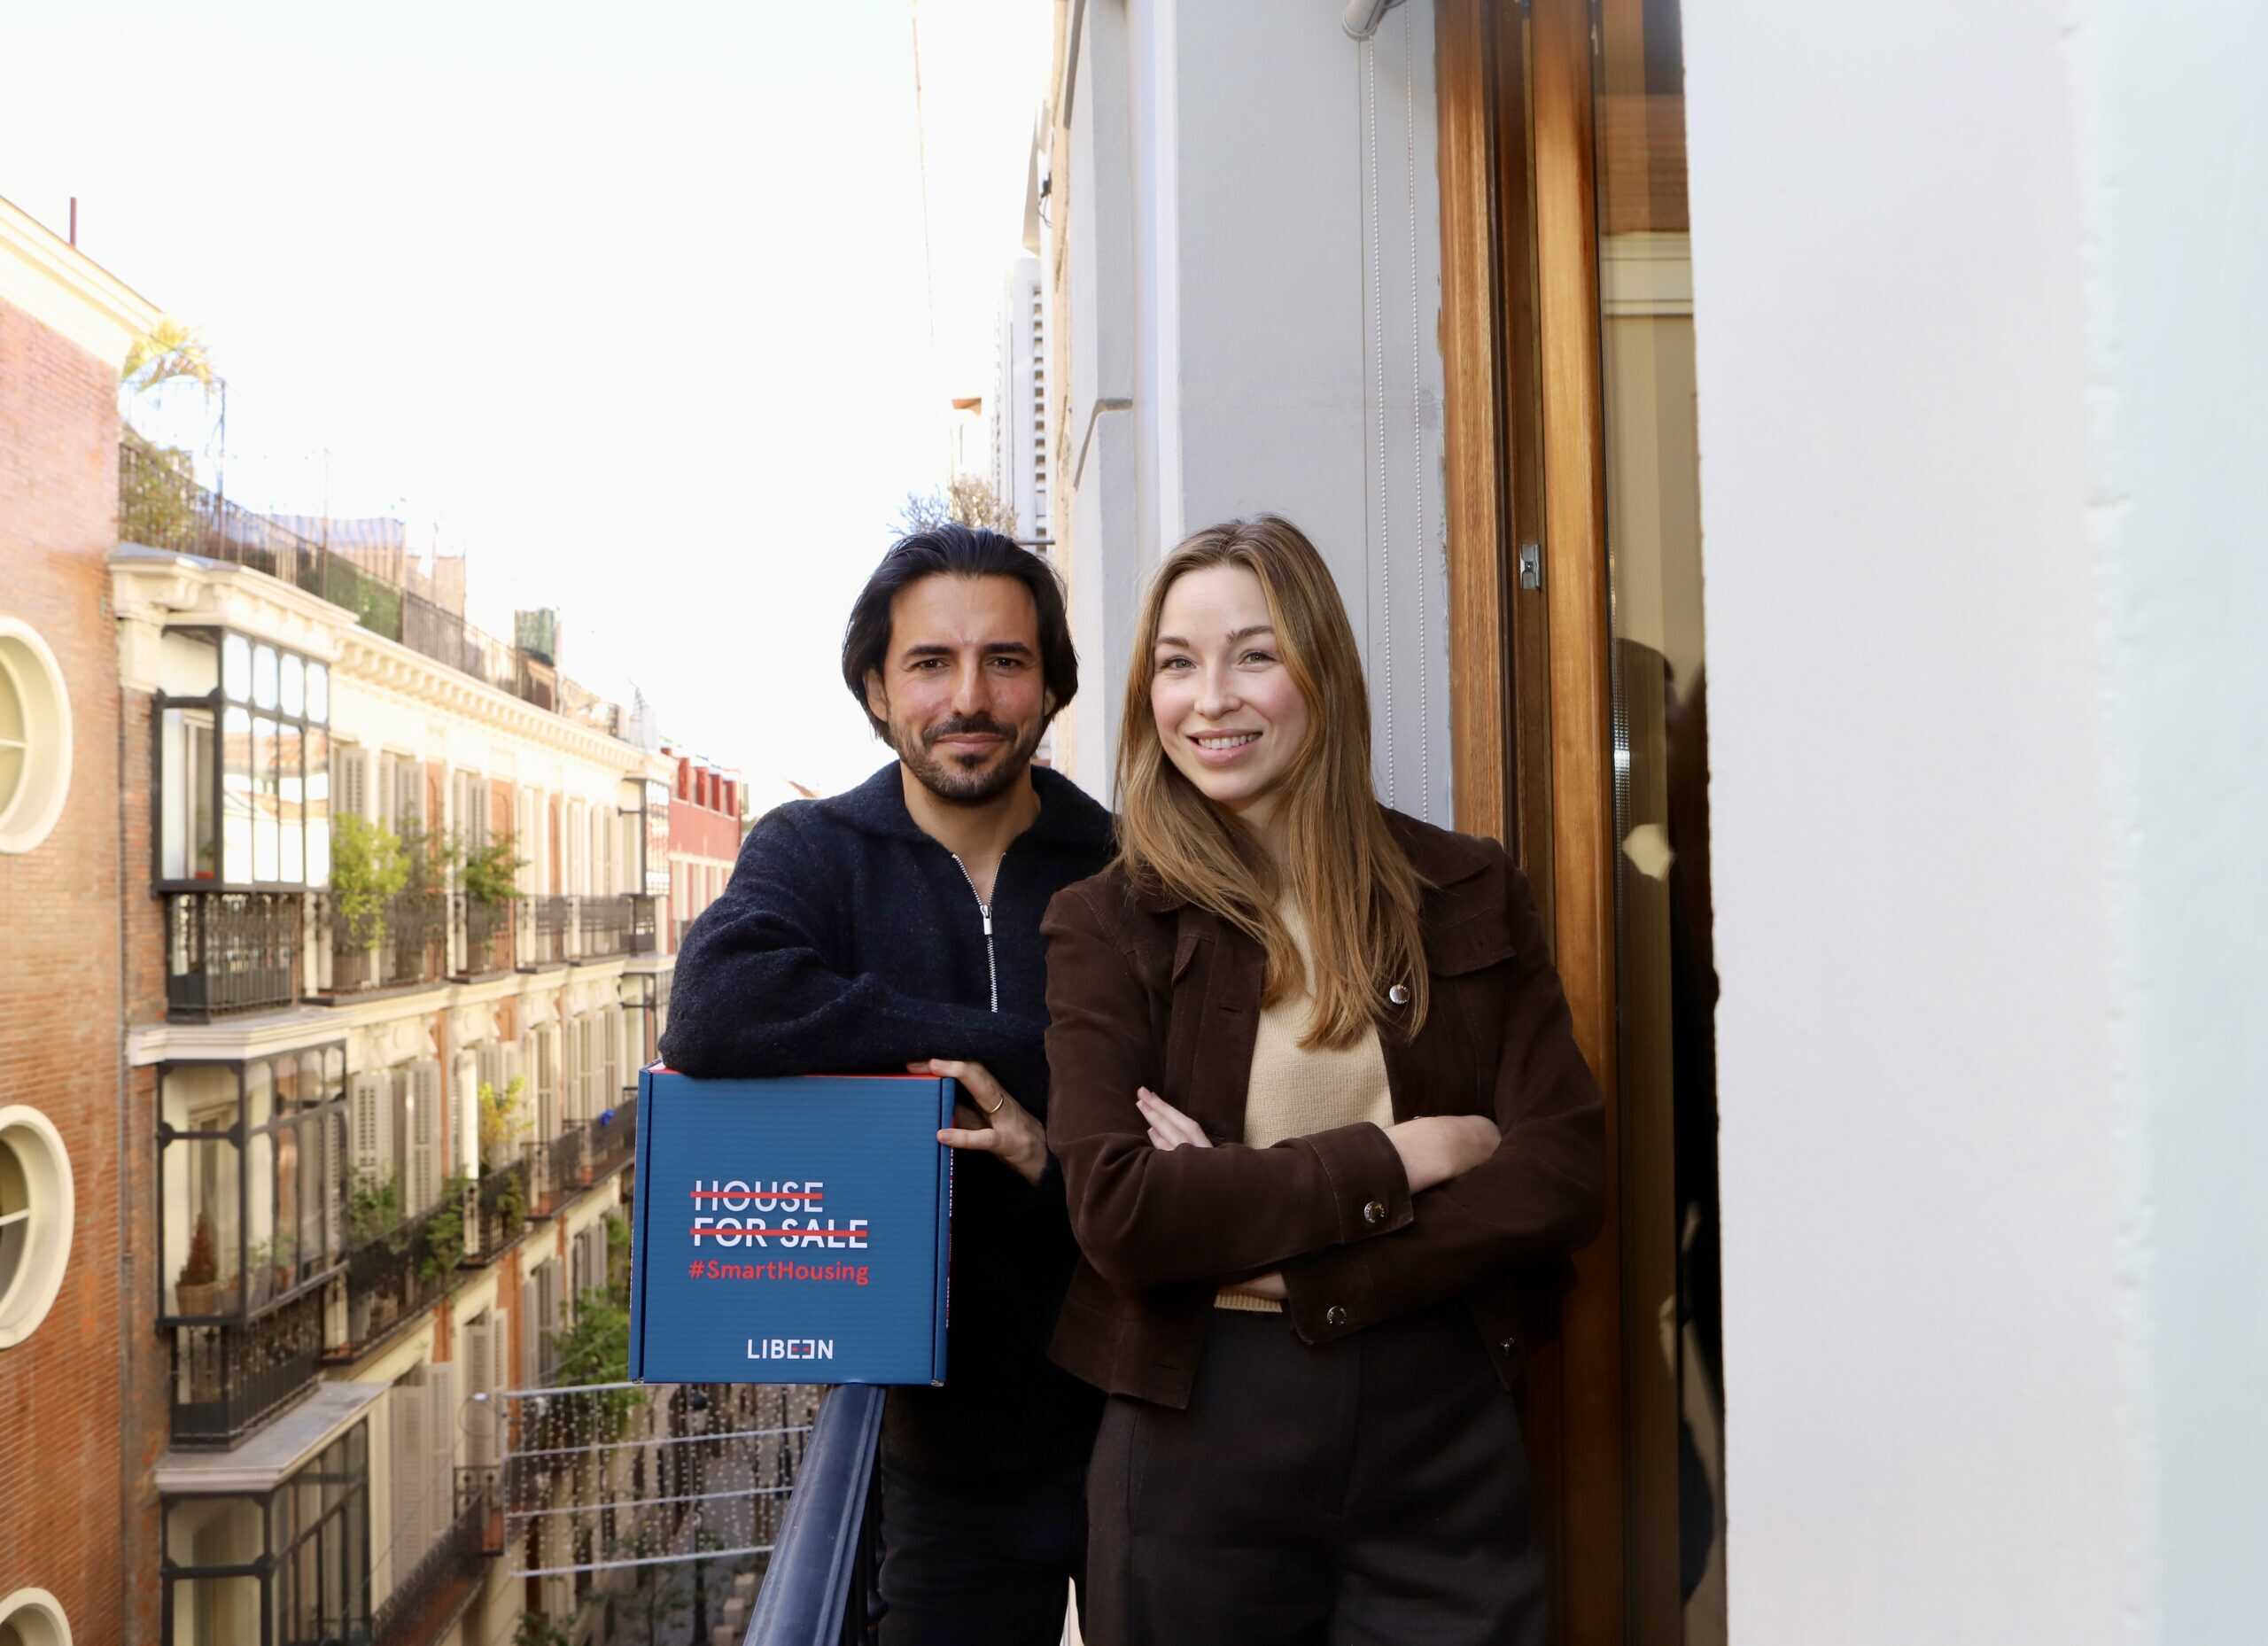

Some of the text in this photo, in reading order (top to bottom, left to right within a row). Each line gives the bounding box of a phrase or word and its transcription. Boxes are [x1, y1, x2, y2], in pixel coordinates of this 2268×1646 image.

[694, 1180, 823, 1213] HOUSE
[694, 1217, 868, 1248] FOR SALE
[689, 1260, 869, 1286] #SmartHousing
